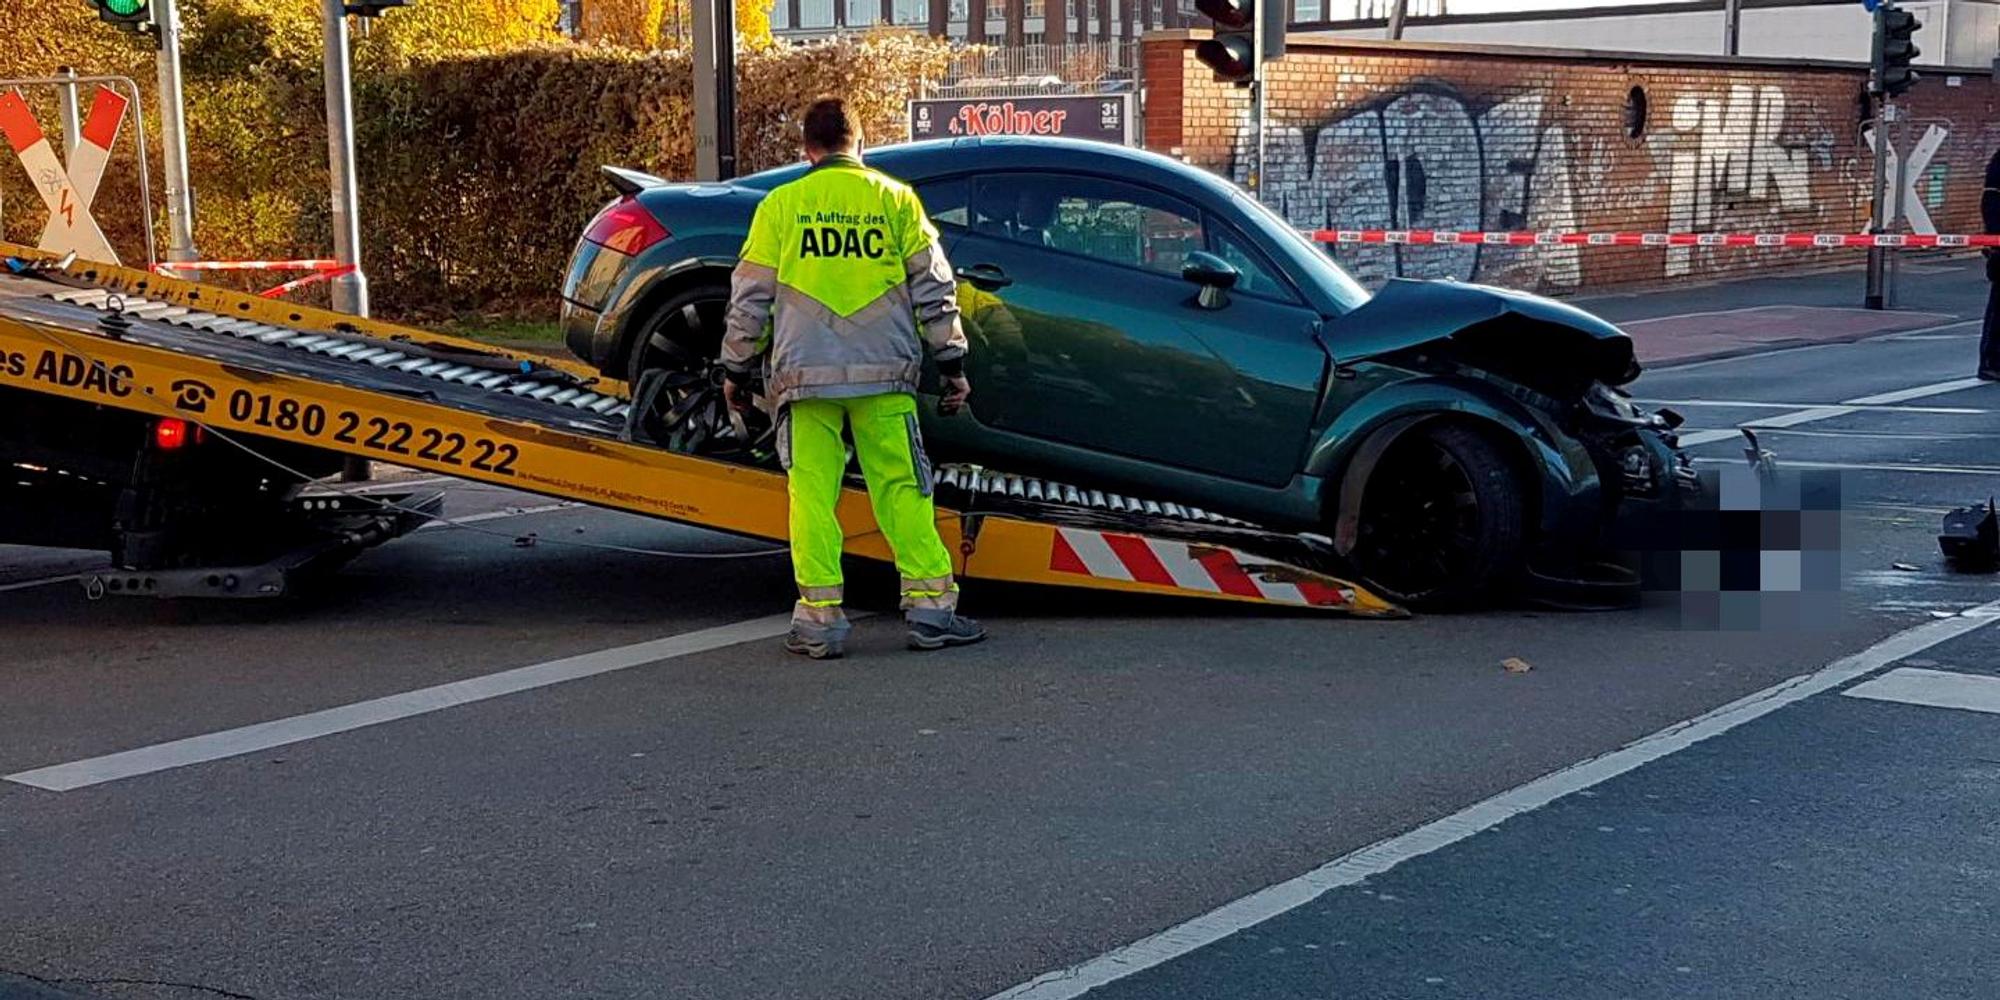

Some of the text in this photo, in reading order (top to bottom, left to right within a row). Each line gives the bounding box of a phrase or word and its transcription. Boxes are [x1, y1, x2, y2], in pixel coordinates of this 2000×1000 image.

[919, 107, 929, 120] 6
[1101, 102, 1118, 116] 31
[959, 102, 1067, 136] Kölner
[815, 211, 860, 226] Auftrag
[863, 212, 886, 225] des
[800, 227, 885, 259] ADAC
[1757, 236, 1781, 245] POLIZEI
[1817, 236, 1841, 245] POLIZEI
[1877, 236, 1902, 245] POLIZEI
[1939, 236, 1965, 246] POLIZEI
[33, 350, 134, 398] ADAC
[229, 389, 326, 437] 0180
[333, 411, 360, 444] 2
[470, 439, 519, 476] 22
